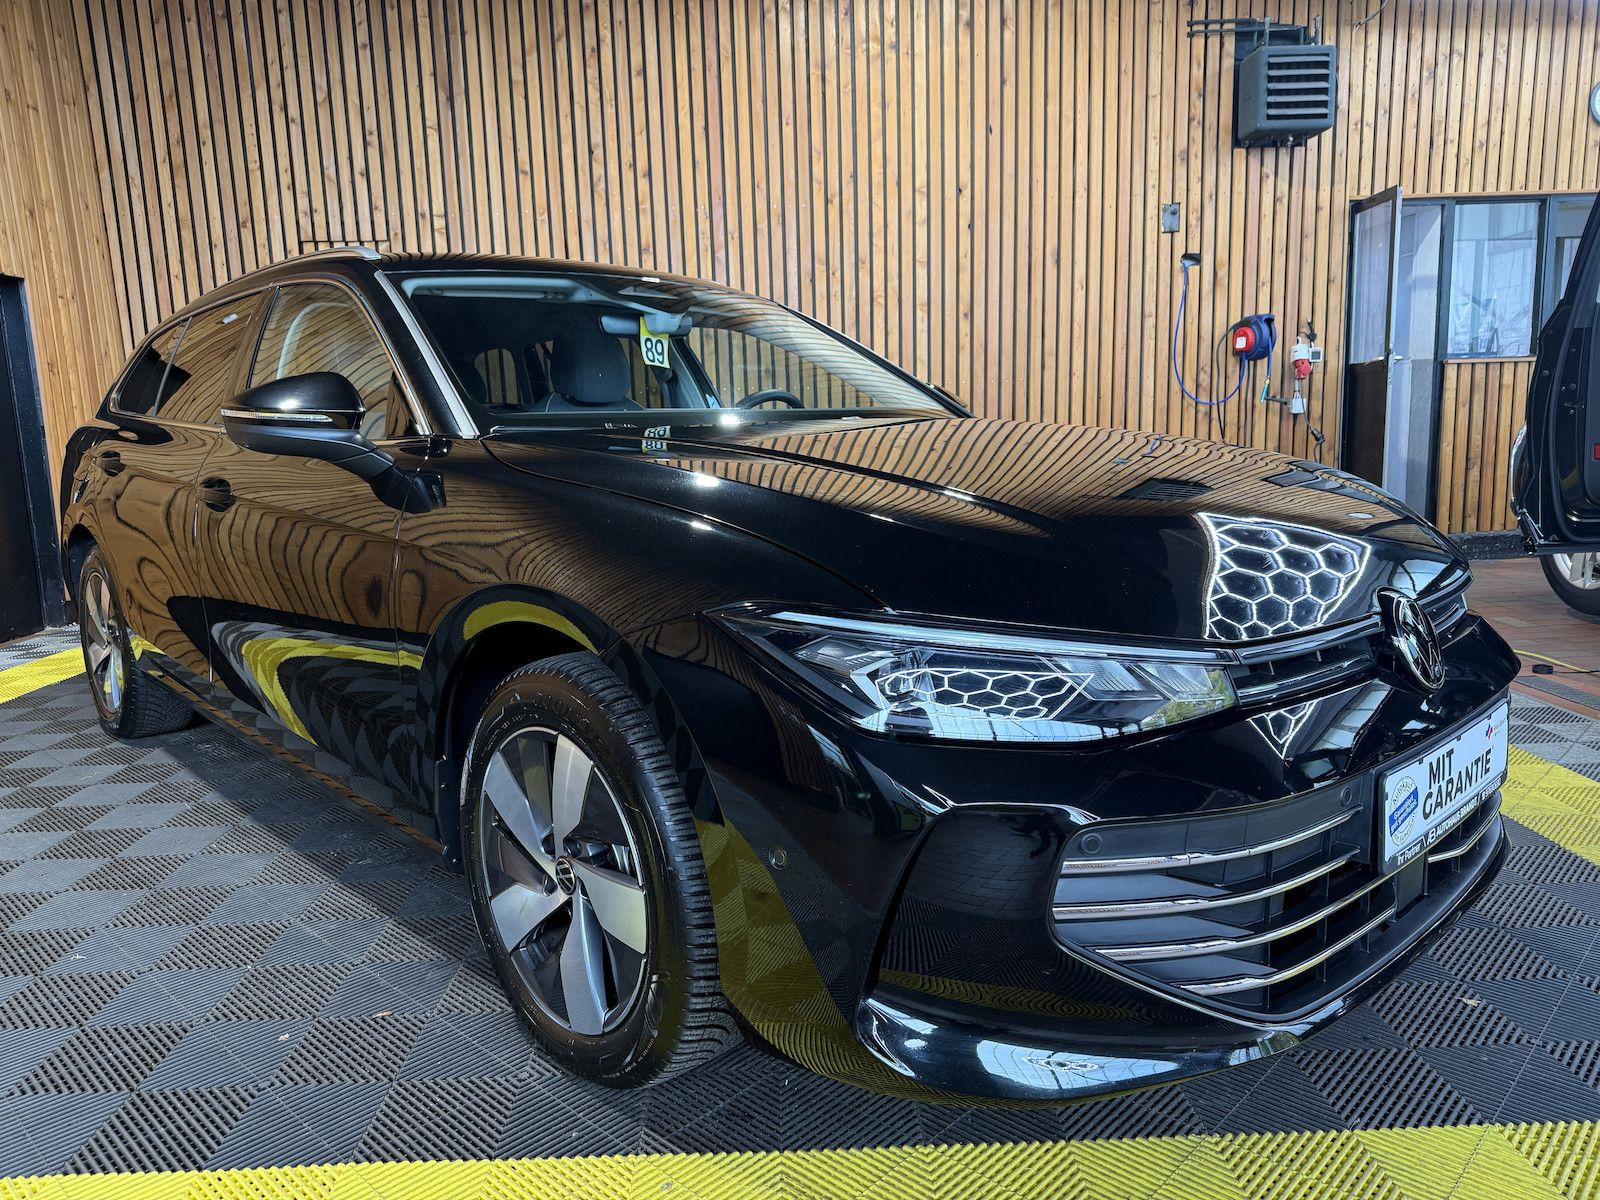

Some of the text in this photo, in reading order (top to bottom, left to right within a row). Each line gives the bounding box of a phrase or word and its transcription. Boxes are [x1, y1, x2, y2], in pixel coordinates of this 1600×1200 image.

[644, 337, 665, 365] 89
[1422, 748, 1492, 821] GARANTIE
[1428, 748, 1455, 791] MIT
